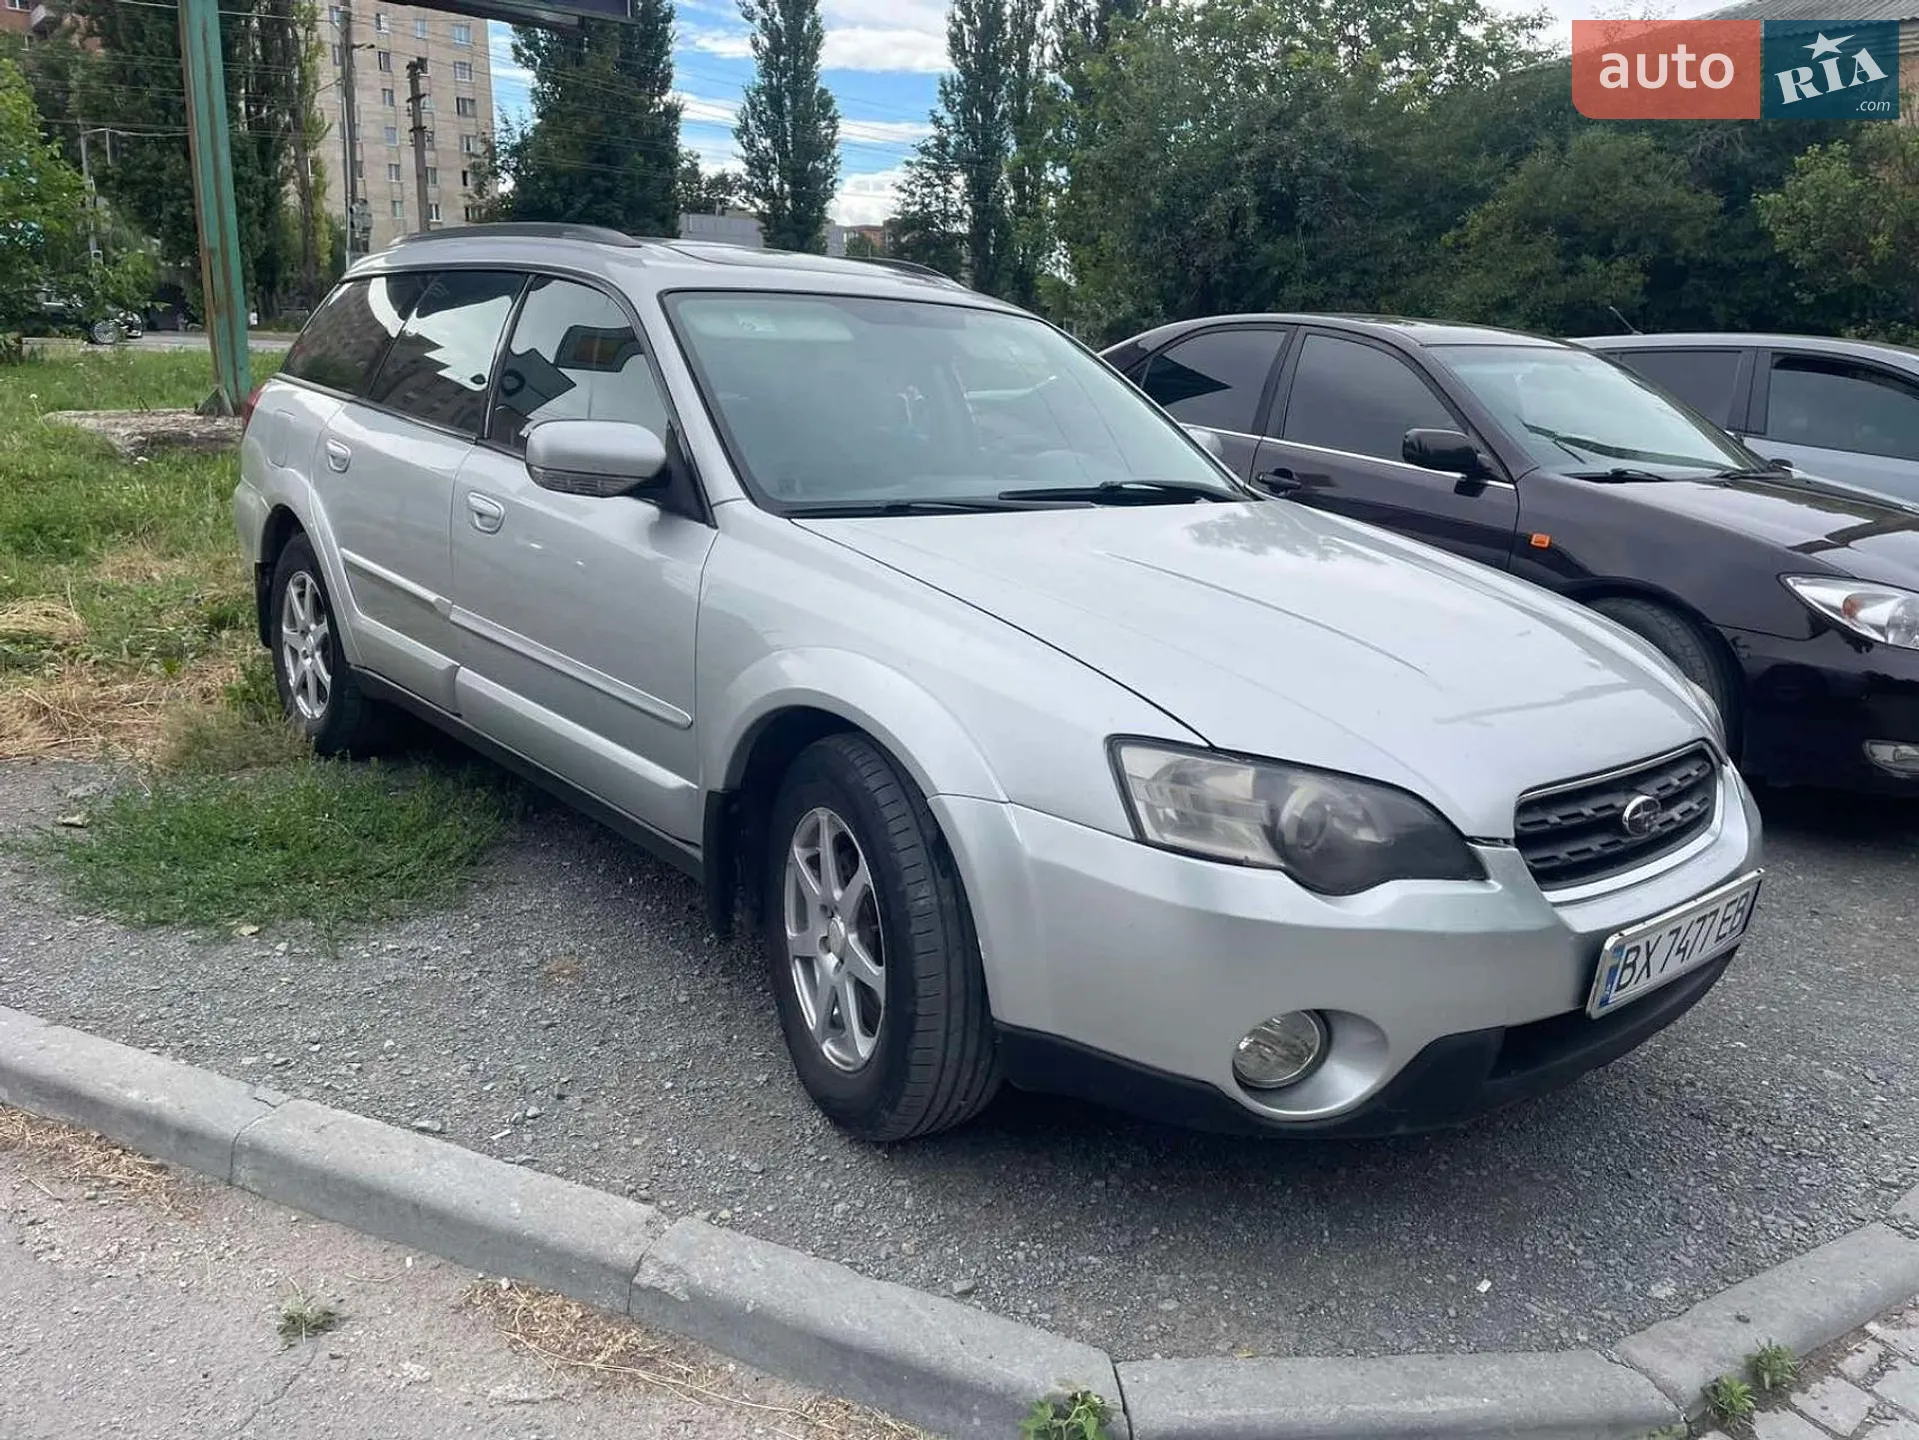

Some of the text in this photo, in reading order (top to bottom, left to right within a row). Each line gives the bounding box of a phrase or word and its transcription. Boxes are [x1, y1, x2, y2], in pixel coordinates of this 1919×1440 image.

[1614, 890, 1749, 993] BX 7477 EB
